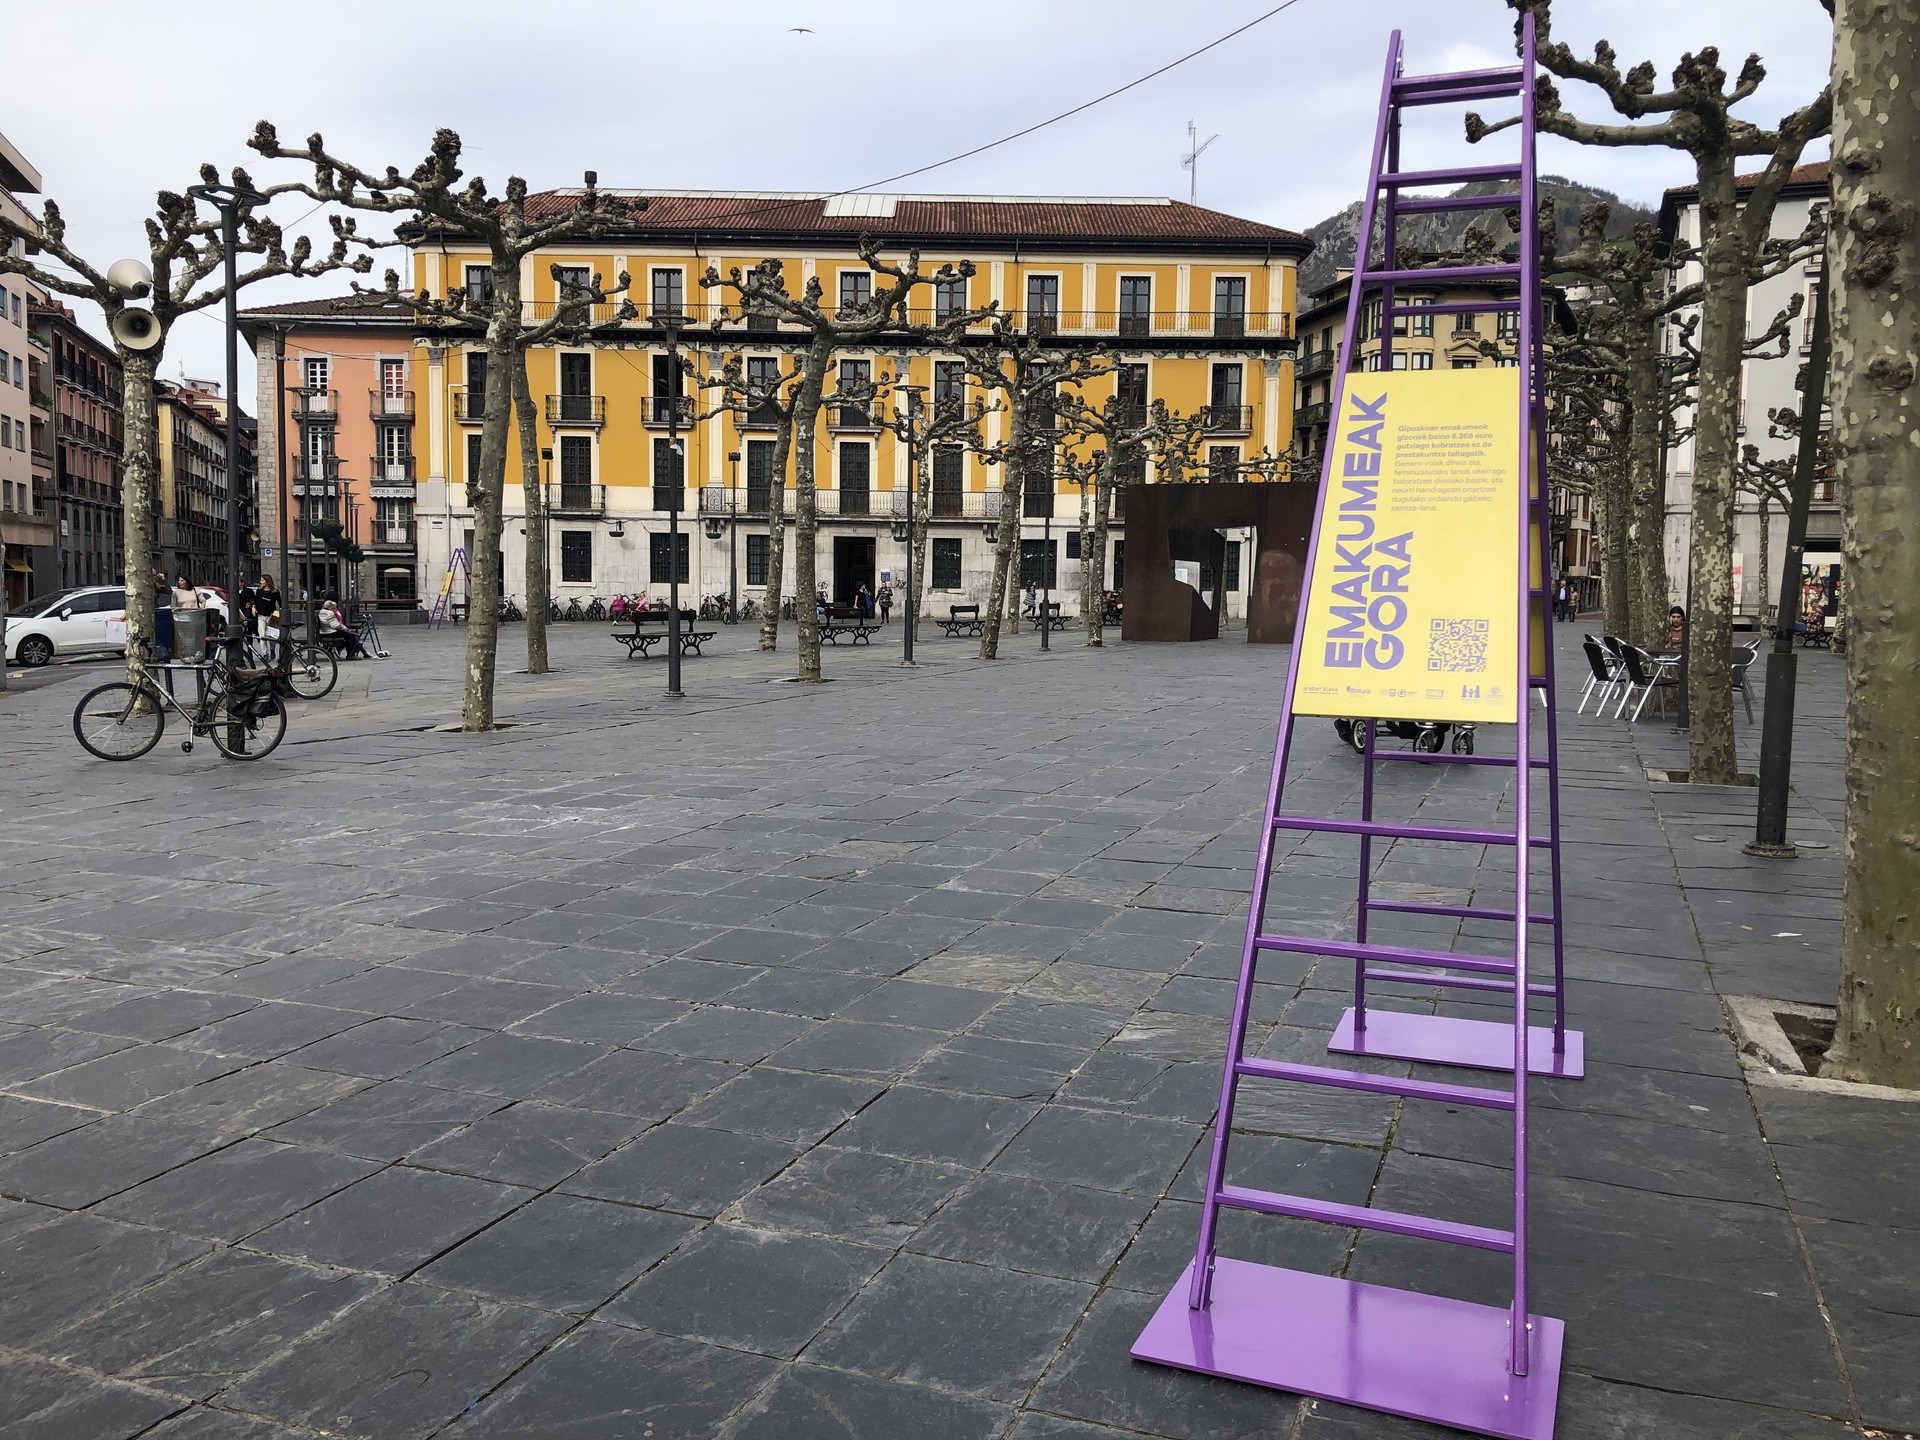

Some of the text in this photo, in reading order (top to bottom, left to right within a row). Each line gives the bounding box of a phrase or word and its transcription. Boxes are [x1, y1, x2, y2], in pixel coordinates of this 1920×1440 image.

[1398, 425, 1439, 433] Gipuzkoan
[1397, 434, 1427, 442] gizonek
[1396, 443, 1430, 451] gutxiago
[1472, 468, 1507, 476] okerrago
[1324, 391, 1388, 669] EMAKUMEAK
[1364, 531, 1414, 670] GORA
